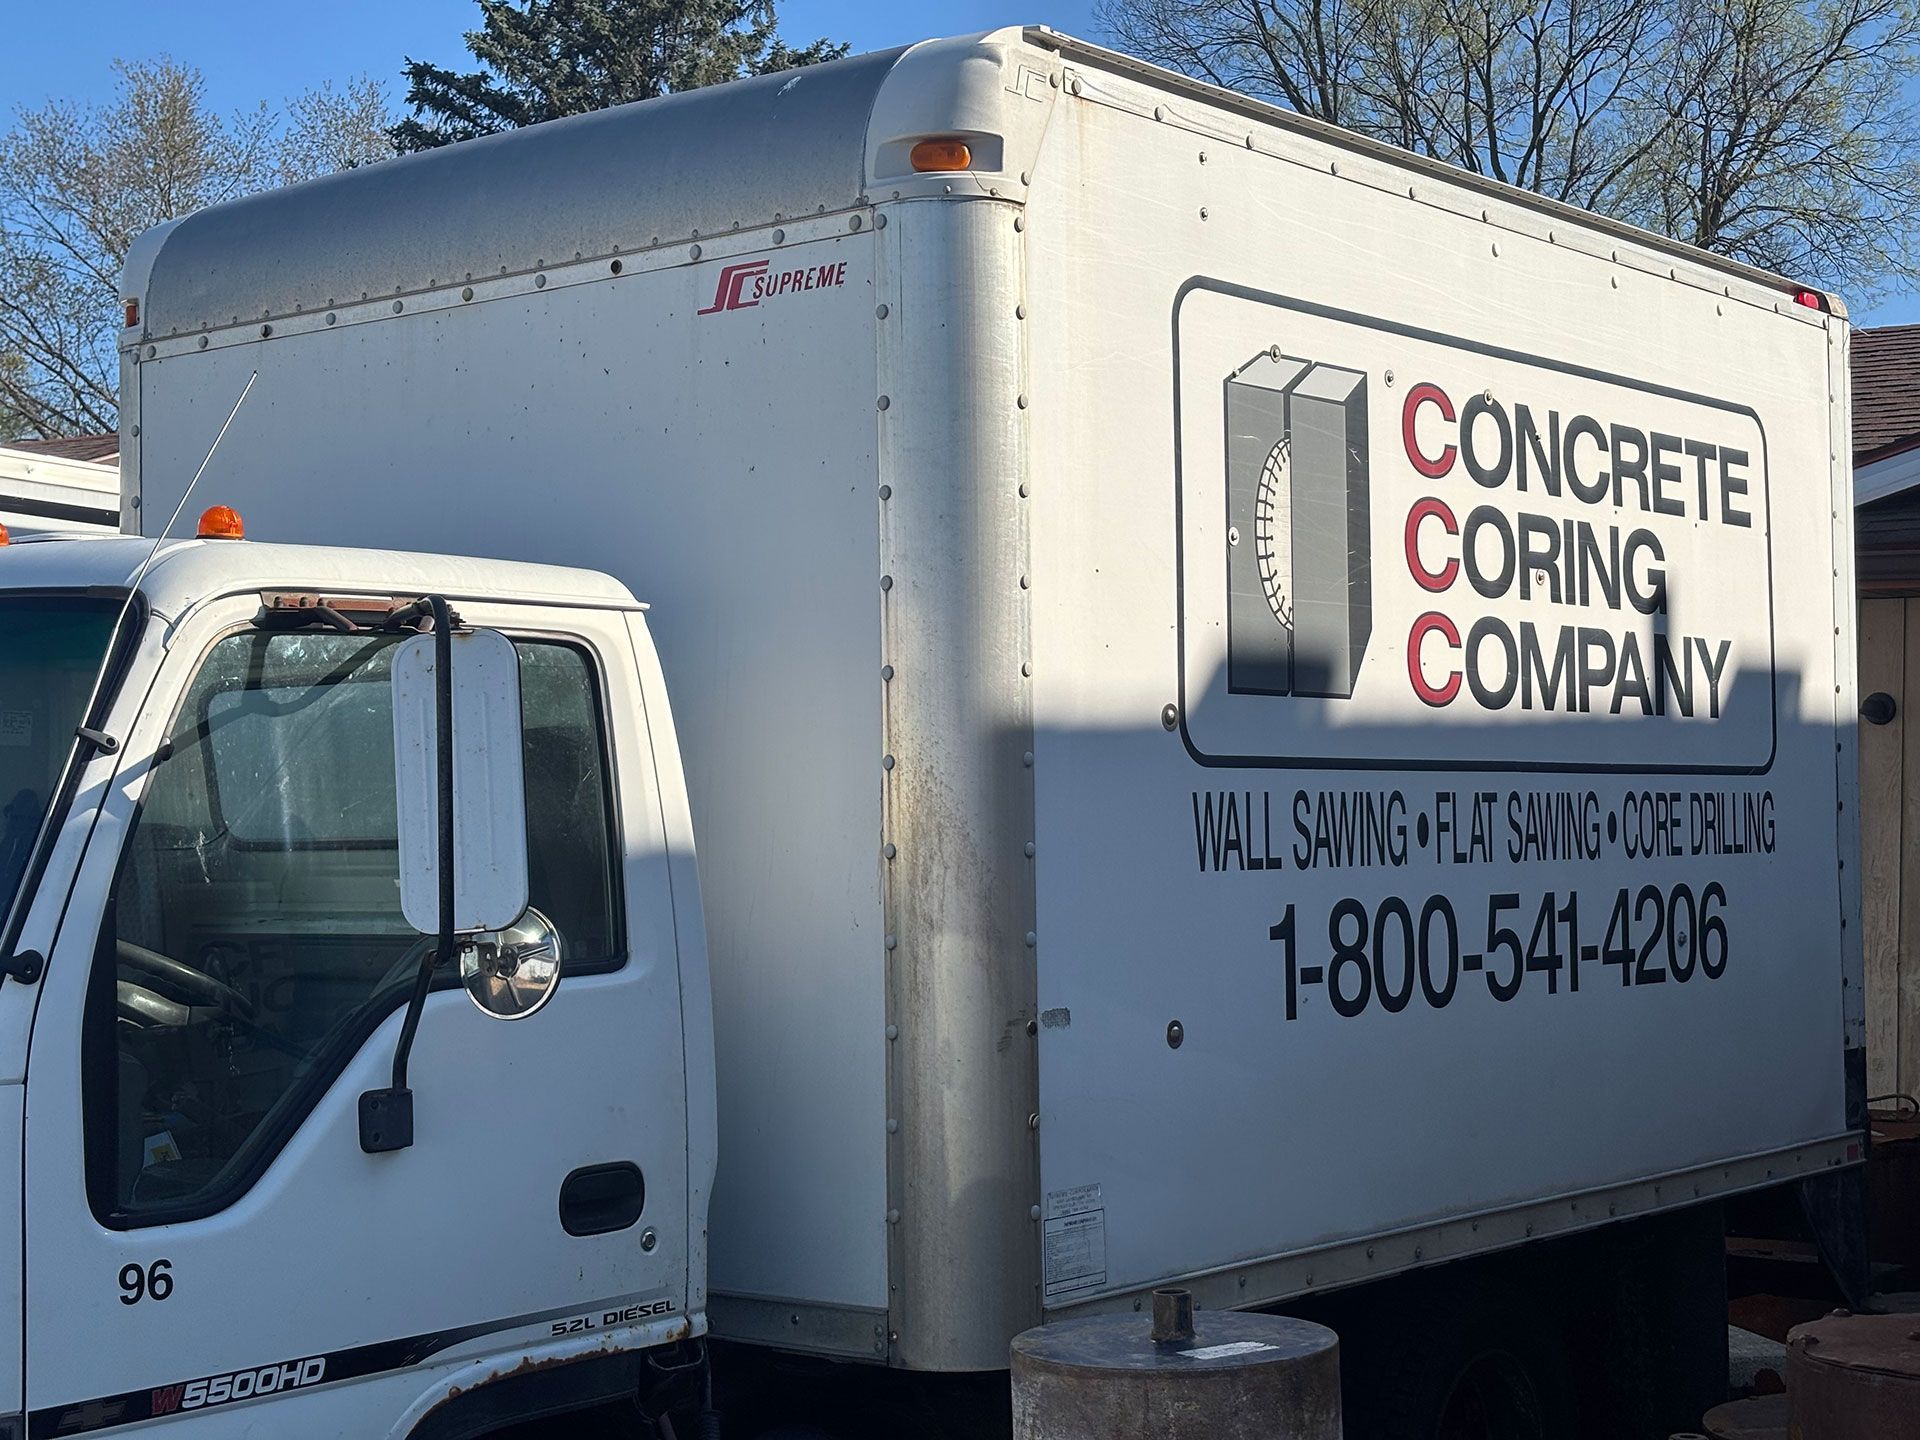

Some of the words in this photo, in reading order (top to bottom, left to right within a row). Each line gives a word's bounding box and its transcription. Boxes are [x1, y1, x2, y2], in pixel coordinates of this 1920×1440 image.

[753, 262, 848, 300] SUPREME
[1402, 382, 1752, 528] CONCRETE
[1404, 496, 1667, 615] CORING
[1407, 611, 1732, 719] COMPANY
[1192, 792, 1282, 872] WALL
[1292, 790, 1407, 870] SAWING
[1435, 791, 1498, 864] FLAT
[1507, 791, 1601, 863] SAWING
[1622, 791, 1682, 859] CORE
[1690, 791, 1775, 855] DRILLING
[1269, 881, 1728, 1020] 1-800-541-4206
[118, 1258, 174, 1305] 96
[603, 1300, 676, 1326] DIESEL
[151, 1357, 326, 1415] W5500HD
